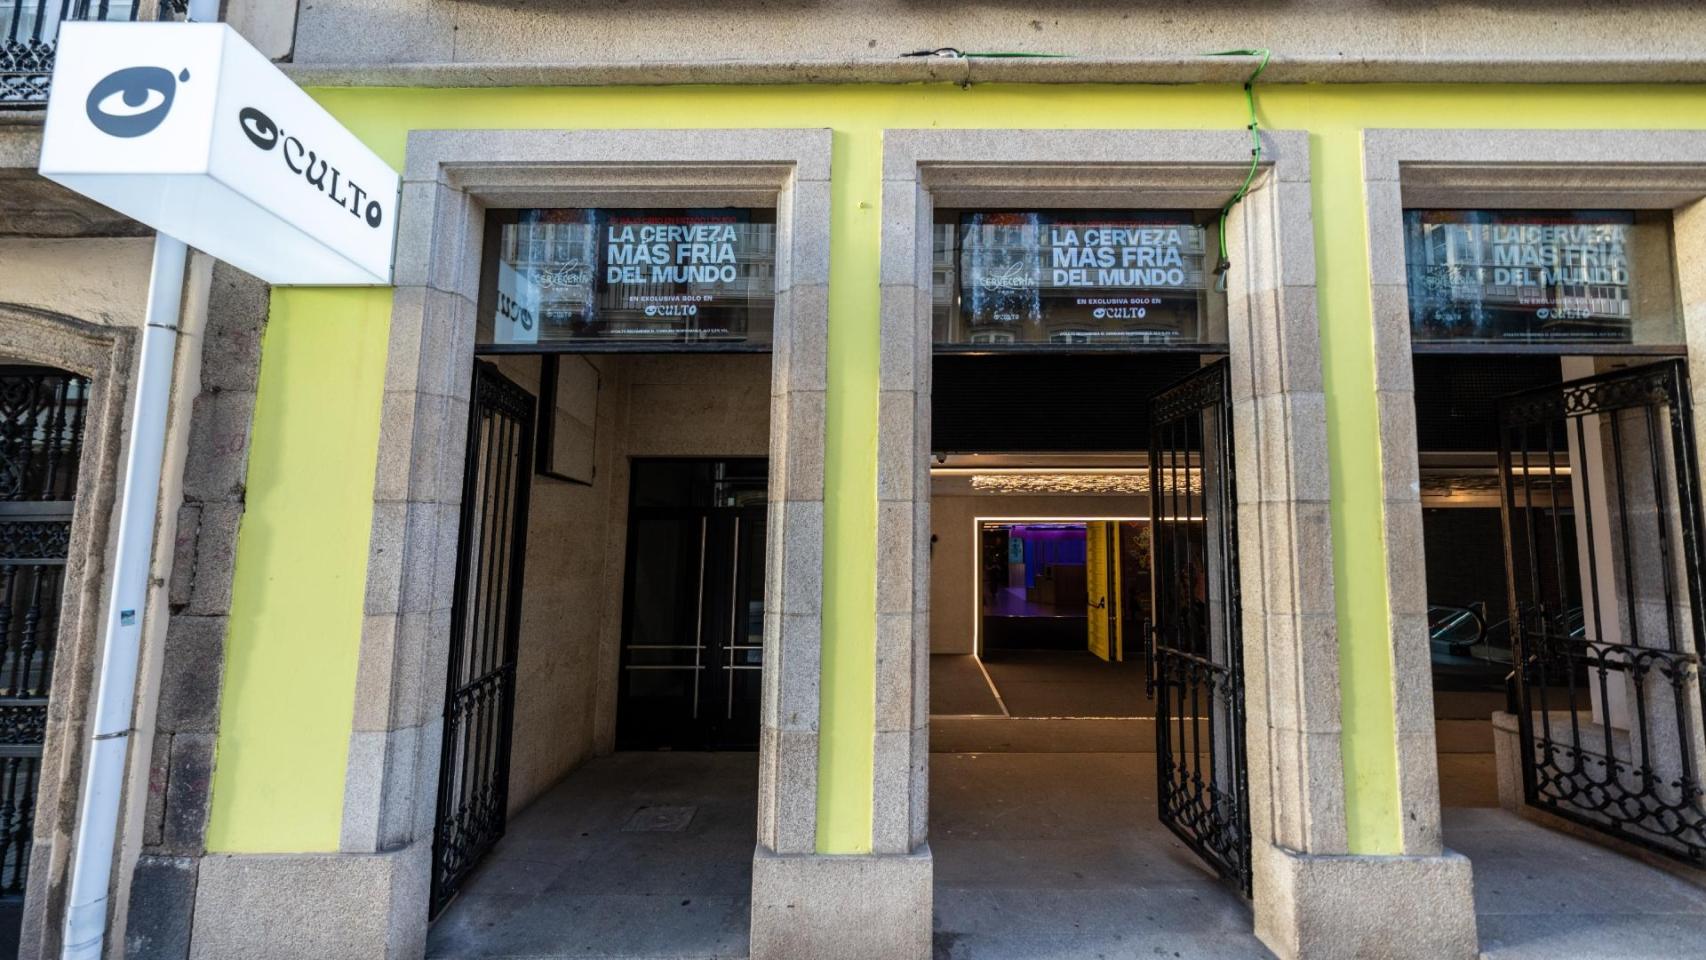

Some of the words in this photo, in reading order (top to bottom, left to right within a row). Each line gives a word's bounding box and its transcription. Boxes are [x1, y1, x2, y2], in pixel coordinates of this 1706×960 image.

[608, 226, 635, 243] LA
[640, 225, 737, 242] CERVEZA
[1052, 229, 1079, 246] LA
[1084, 229, 1182, 246] CERVEZA
[1493, 225, 1521, 244] LA
[676, 239, 737, 264] FRÍA
[1122, 242, 1183, 267] FRÍA
[607, 266, 647, 284] DEL
[652, 265, 737, 283] MUNDO
[1053, 269, 1094, 286] DEL
[1099, 268, 1184, 286] MUNDO
[1494, 267, 1536, 286] DEL
